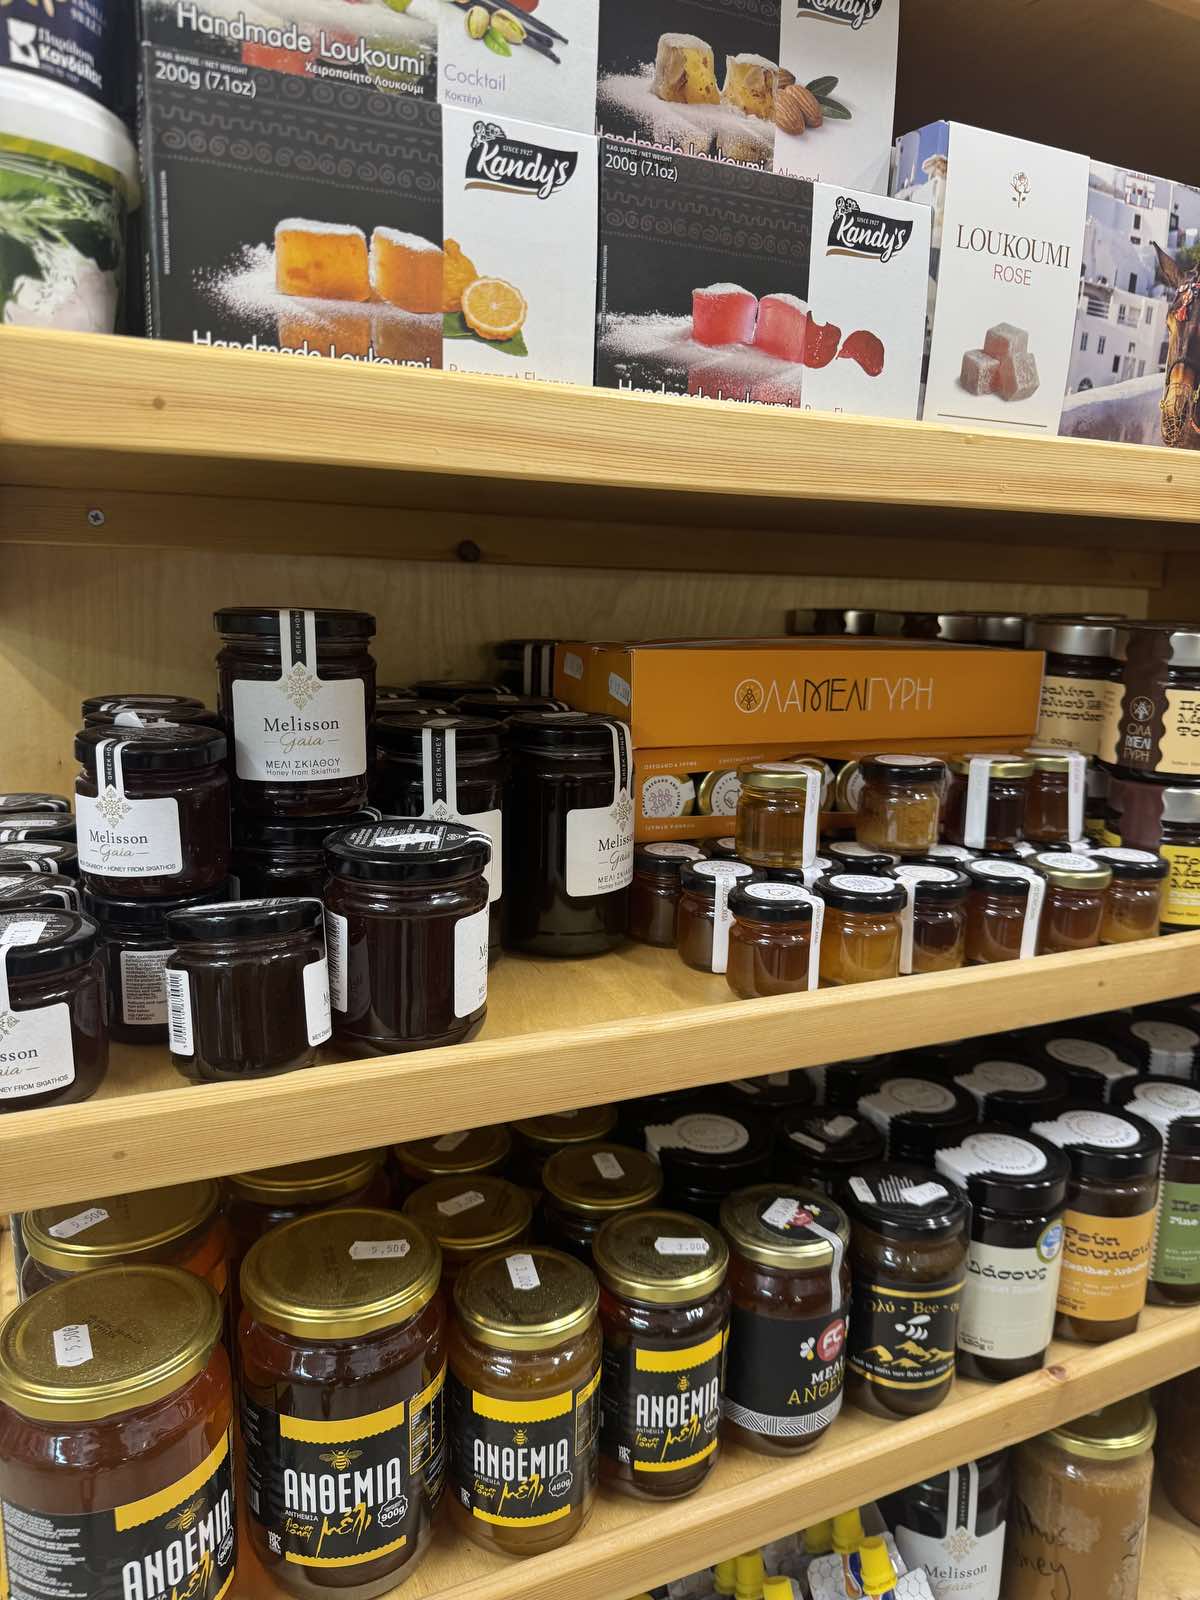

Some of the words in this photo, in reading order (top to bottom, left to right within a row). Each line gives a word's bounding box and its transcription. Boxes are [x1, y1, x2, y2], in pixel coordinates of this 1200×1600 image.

[176, 4, 313, 54] Handmade
[319, 30, 426, 76] Loukoumi
[155, 61, 201, 90] 200g
[204, 70, 257, 99] (7.1oz)
[304, 60, 373, 86] Χειροποίητο
[374, 77, 425, 96] Λουκούμι
[443, 63, 506, 92] Cocktail
[444, 88, 484, 107] Κοκτέηλ
[605, 153, 638, 176] 200g
[641, 159, 678, 183] (7.1oz)
[652, 153, 673, 163] WEIGHT
[476, 141, 570, 199] Kandy's
[835, 214, 907, 263] Kandy's
[955, 223, 1072, 270] LOUKOUMI
[992, 263, 1033, 287] ROSE
[263, 715, 340, 733] Melisson
[435, 736, 443, 764] HONEY
[265, 760, 291, 769] ΜΕΛΙ
[294, 757, 341, 769] ΣΚΙΑΘΟΥ
[266, 768, 290, 777] Honey
[291, 768, 309, 776] from
[311, 767, 341, 776] Skiathos
[436, 767, 444, 793] GREEK
[89, 828, 149, 844] Melisson
[99, 843, 135, 863] Gaia
[145, 863, 176, 872] SKIATHOS
[13, 1082, 35, 1092] FROM
[35, 1073, 70, 1089] SKIATHOS
[551, 1479, 571, 1492] 450g
[284, 1509, 319, 1522] ANTHEMIA
[381, 1505, 405, 1522] 900g
[923, 1561, 989, 1581] Melisson
